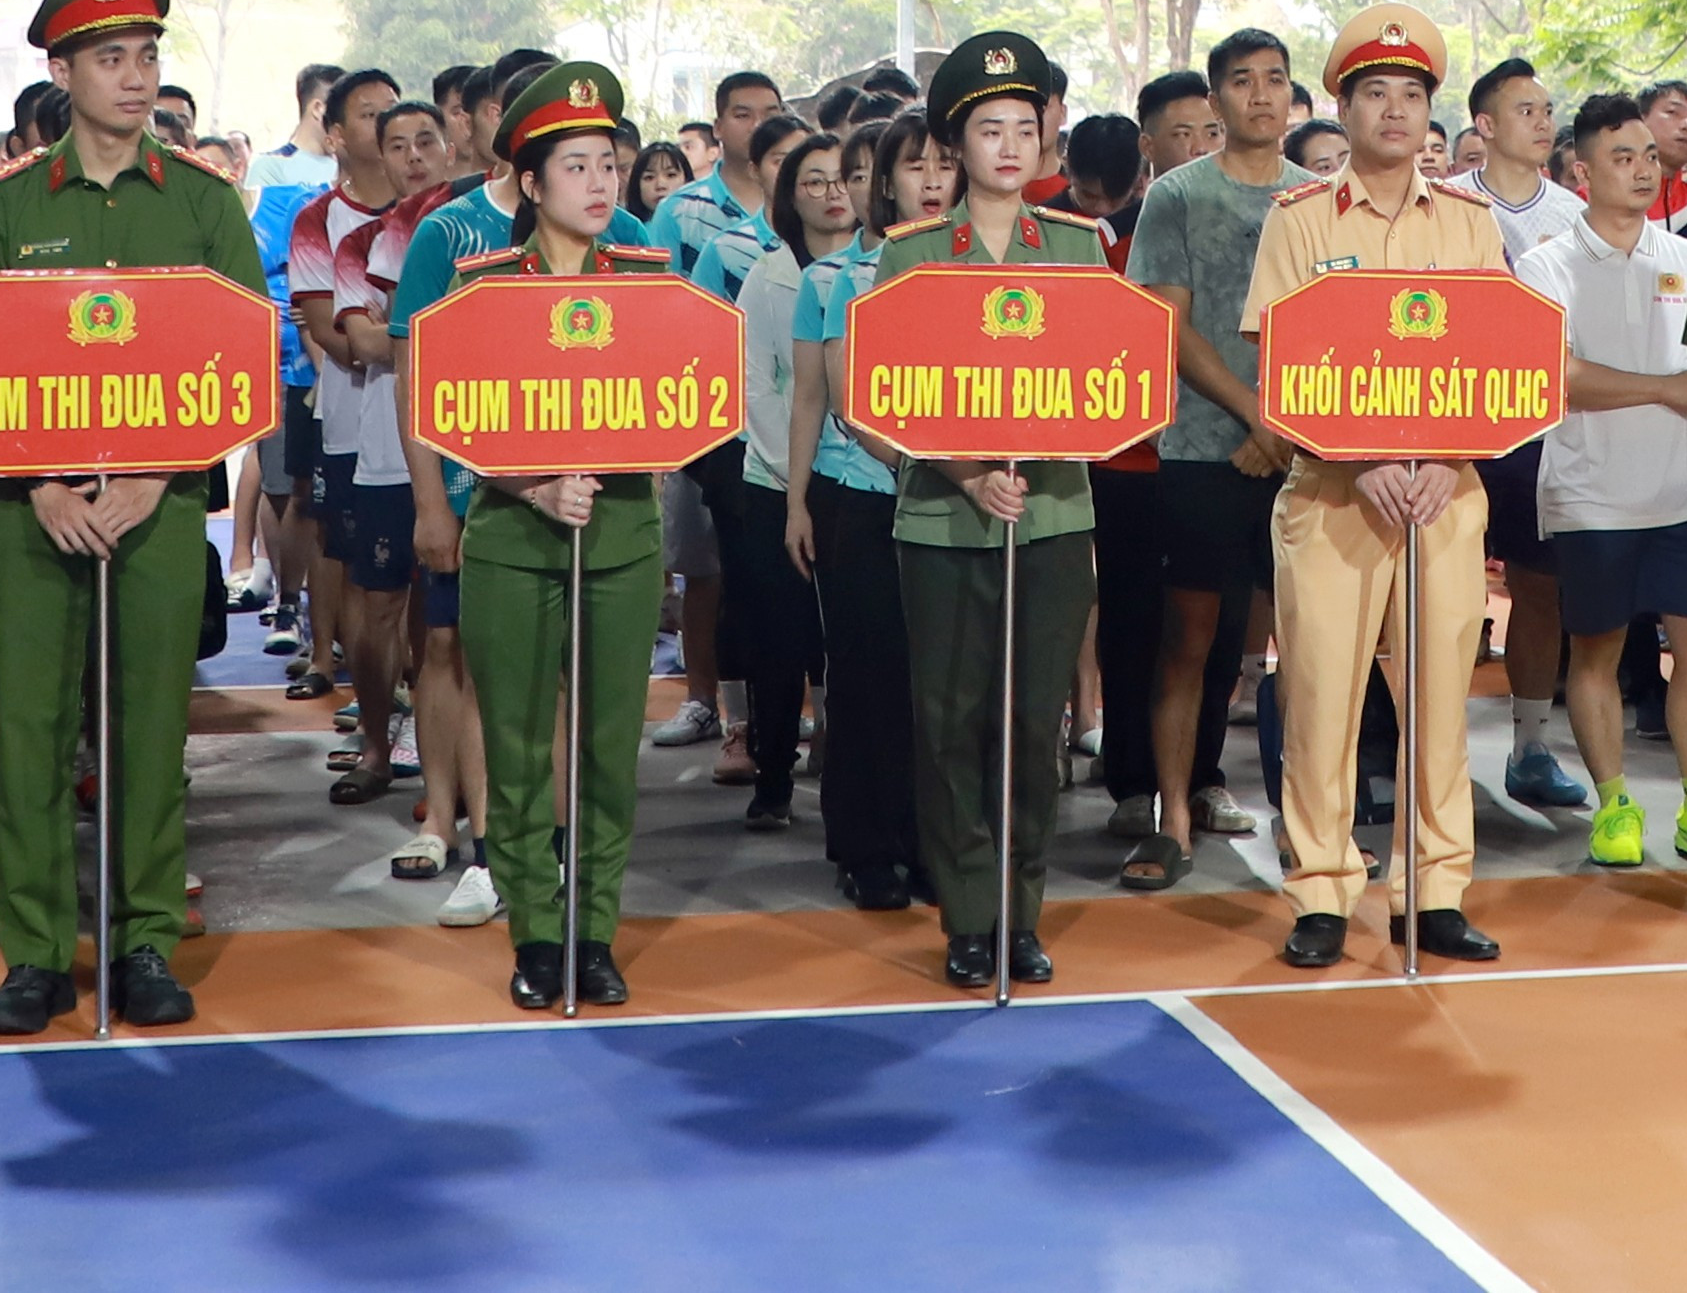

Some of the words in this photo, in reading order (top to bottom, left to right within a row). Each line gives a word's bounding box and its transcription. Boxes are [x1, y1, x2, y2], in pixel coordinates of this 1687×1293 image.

[37, 375, 91, 431] THI
[99, 373, 168, 429] ĐUA
[176, 352, 222, 427] SỐ
[231, 370, 252, 426] 3
[433, 378, 511, 446] CỤM
[519, 378, 573, 432] THI
[580, 376, 647, 431] ĐUA
[655, 357, 701, 430] SỐ
[708, 375, 729, 428] 2
[869, 364, 944, 430] CỤM
[952, 365, 1004, 419] THI
[1011, 366, 1075, 420] ĐUA
[1083, 349, 1129, 421] SỐ
[1137, 369, 1152, 420] 1
[1279, 347, 1343, 417] KHỐI
[1349, 348, 1422, 418] CẢNH
[1427, 356, 1479, 418] SÁT
[1483, 367, 1550, 425] QLHC
